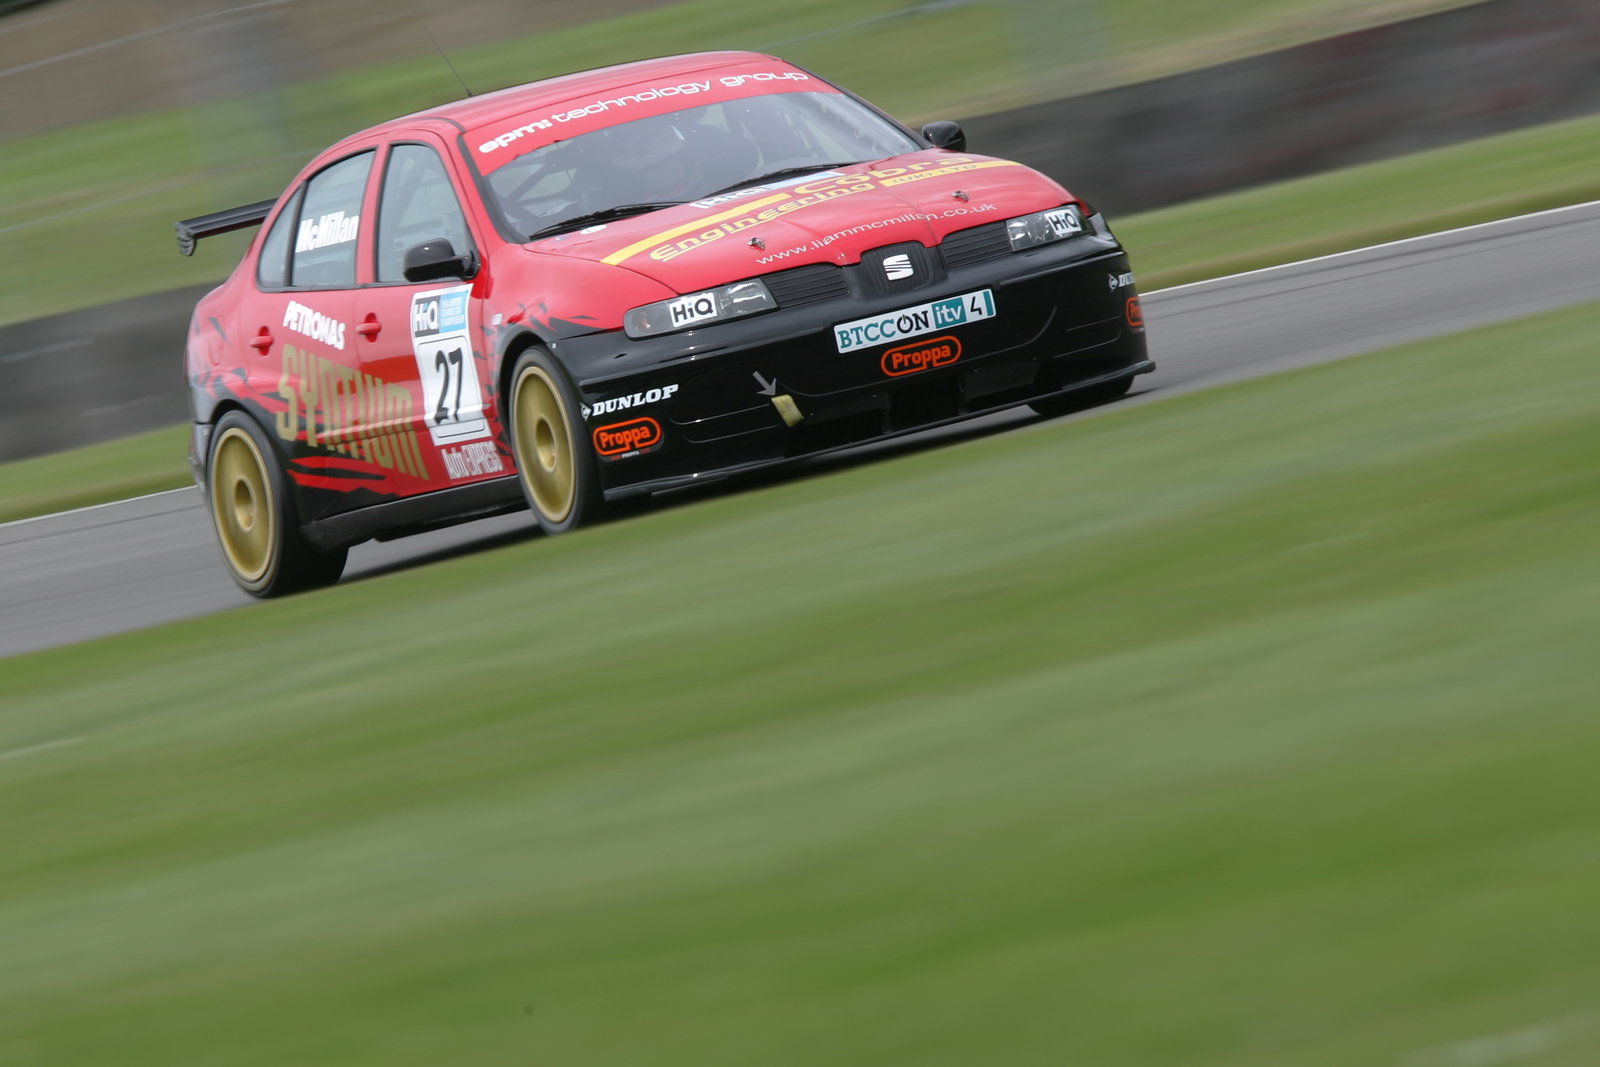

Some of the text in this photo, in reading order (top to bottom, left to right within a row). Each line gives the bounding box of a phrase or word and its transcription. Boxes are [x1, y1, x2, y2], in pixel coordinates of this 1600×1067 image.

[552, 79, 712, 123] technology
[719, 71, 809, 88] group
[793, 157, 974, 195] Cobra
[650, 182, 876, 262] Engineering
[1048, 213, 1079, 231] HiQ
[283, 300, 346, 350] PETRONAS
[412, 300, 439, 333] HiQ
[672, 298, 714, 323] HiQ
[892, 344, 952, 369] Proppa
[433, 347, 463, 425] 27
[592, 384, 679, 416] DUNLOP
[599, 426, 651, 449] Proppa
